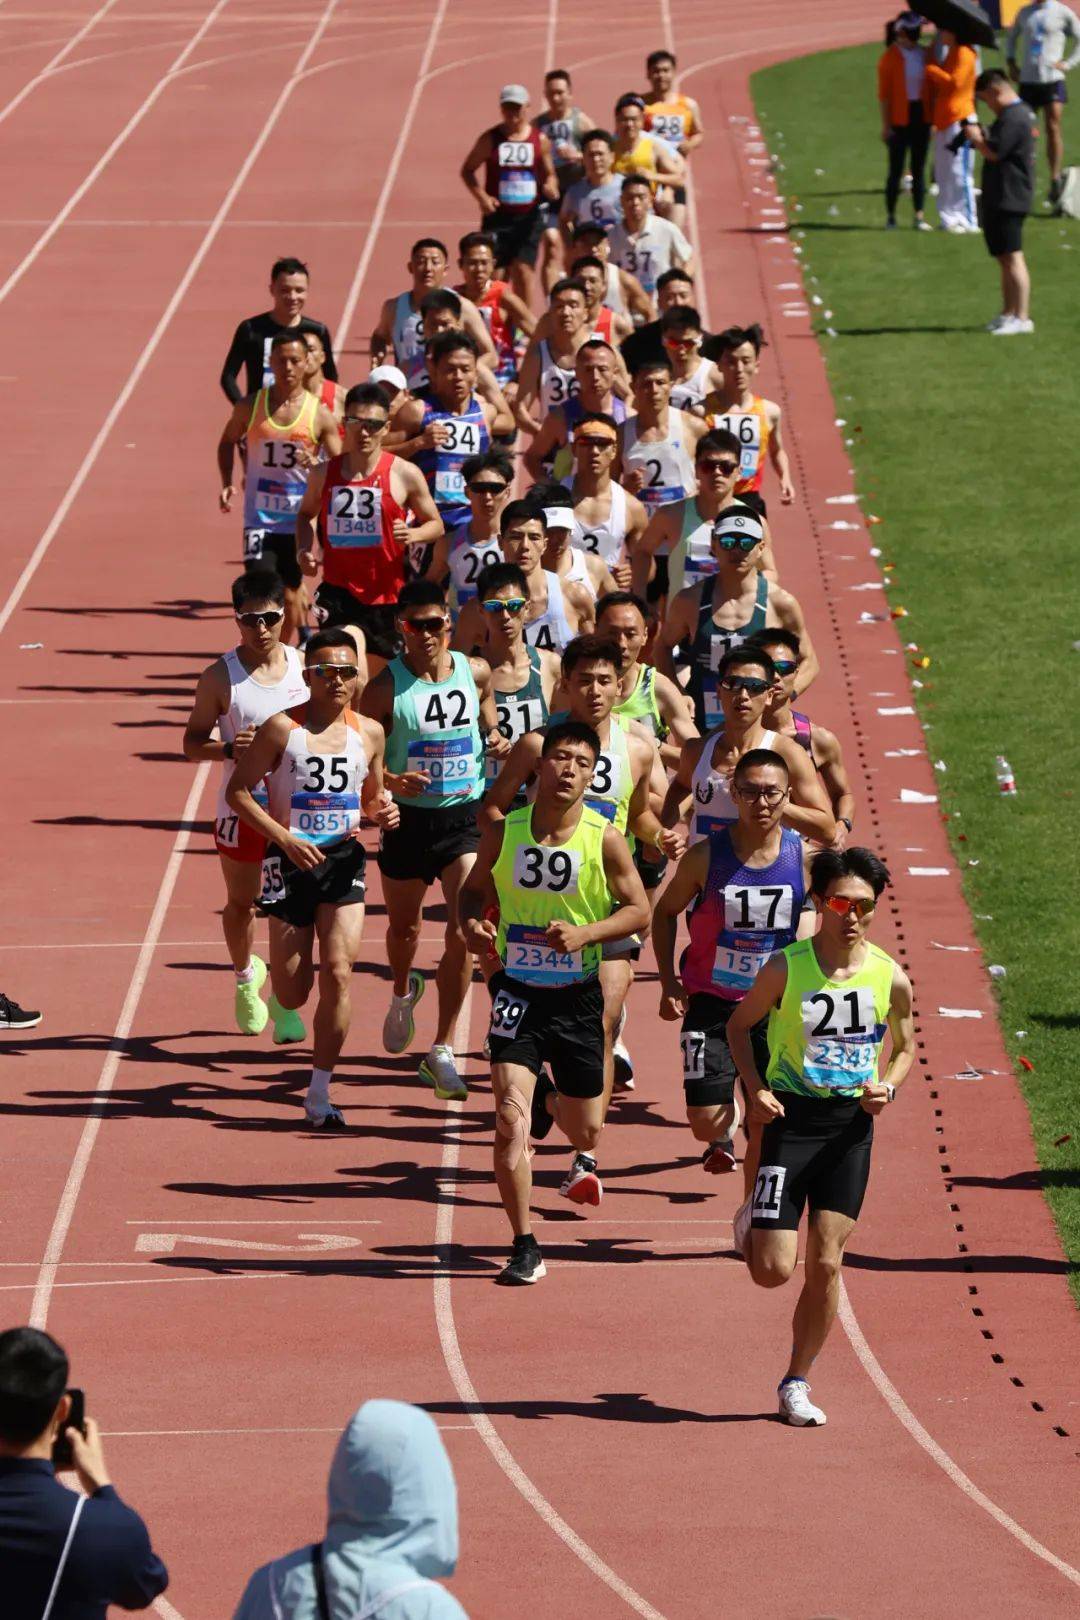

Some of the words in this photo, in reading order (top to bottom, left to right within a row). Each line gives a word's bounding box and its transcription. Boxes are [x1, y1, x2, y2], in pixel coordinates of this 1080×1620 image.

[655, 116, 681, 135] 28
[503, 143, 529, 164] 20
[591, 199, 603, 219] 6
[625, 251, 652, 272] 37
[441, 421, 475, 452] 34
[722, 416, 753, 443] 16
[262, 441, 297, 468] 13
[646, 459, 665, 486] 2
[336, 488, 375, 519] 23
[334, 519, 376, 533] 1348
[424, 689, 470, 729] 42
[496, 703, 531, 739] 31
[303, 756, 348, 793] 35
[416, 759, 468, 778] 1029
[590, 755, 612, 794] 3
[299, 813, 350, 831] 0851
[262, 863, 284, 894] 35
[518, 847, 572, 892] 39
[733, 888, 784, 928] 17
[515, 946, 574, 969] 2344
[726, 951, 765, 973] 151
[493, 996, 524, 1031] 39
[809, 990, 867, 1037] 21
[681, 1038, 704, 1072] 17
[754, 1174, 779, 1211] 21
